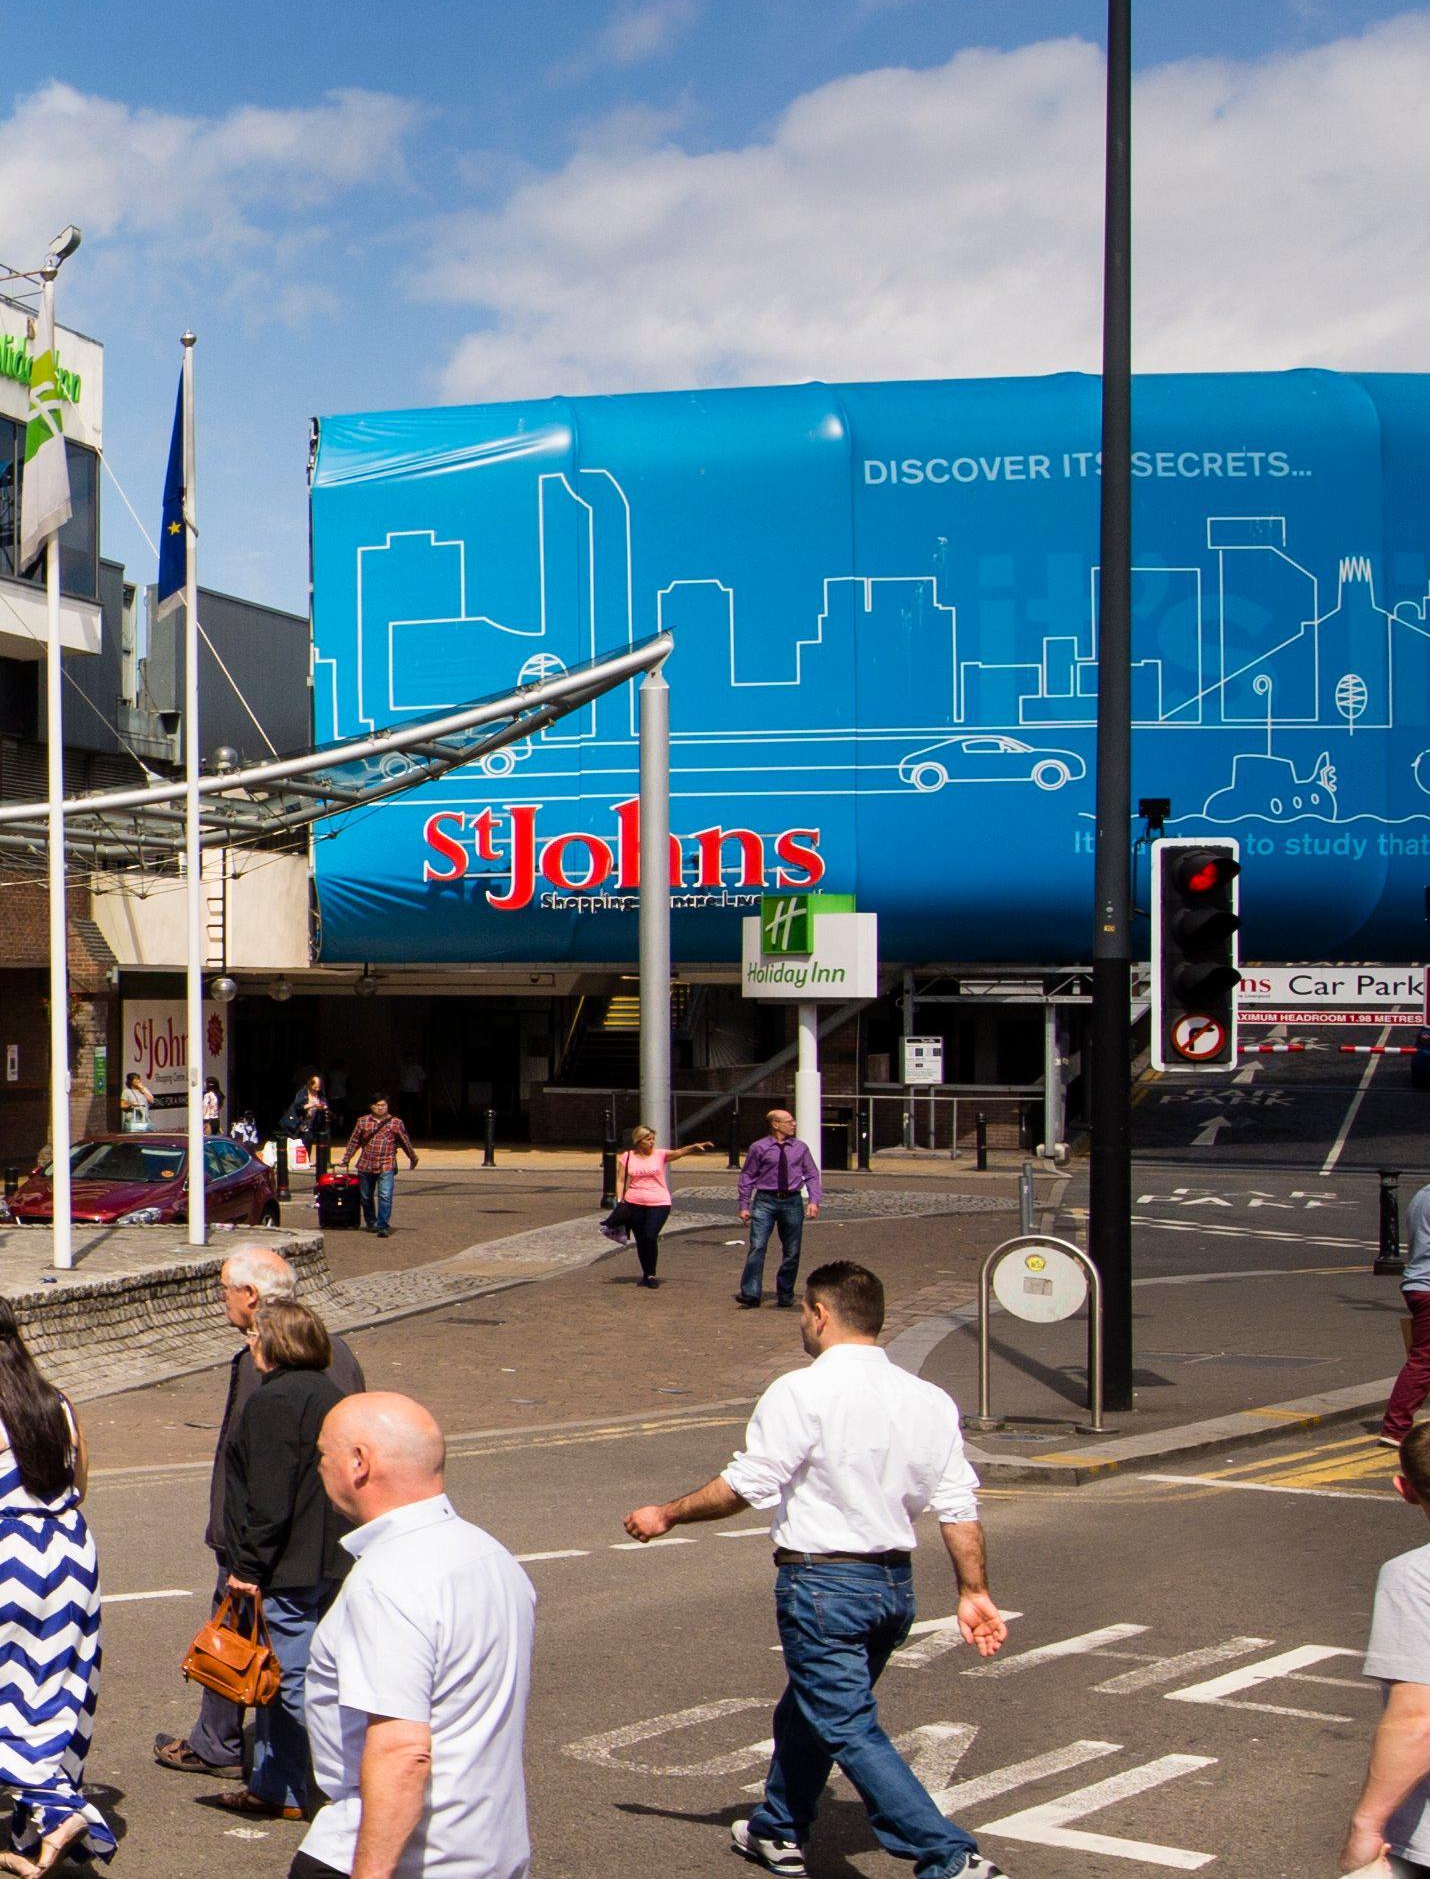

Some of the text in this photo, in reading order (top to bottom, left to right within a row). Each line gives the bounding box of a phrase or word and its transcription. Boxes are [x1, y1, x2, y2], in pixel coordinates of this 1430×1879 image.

[864, 454, 1050, 485] DISCOVER
[1245, 834, 1274, 855] to
[1285, 833, 1368, 860] study
[1377, 833, 1429, 855] that
[748, 962, 846, 989] Holiday Inn
[1288, 975, 1345, 996] Car
[1357, 975, 1424, 996] Park
[1280, 1014, 1346, 1023] HEADROOM
[1350, 1014, 1372, 1023] 1.98
[1375, 1015, 1423, 1024] METRES
[1160, 1095, 1296, 1106] PARK
[1185, 1088, 1284, 1097] CAR
